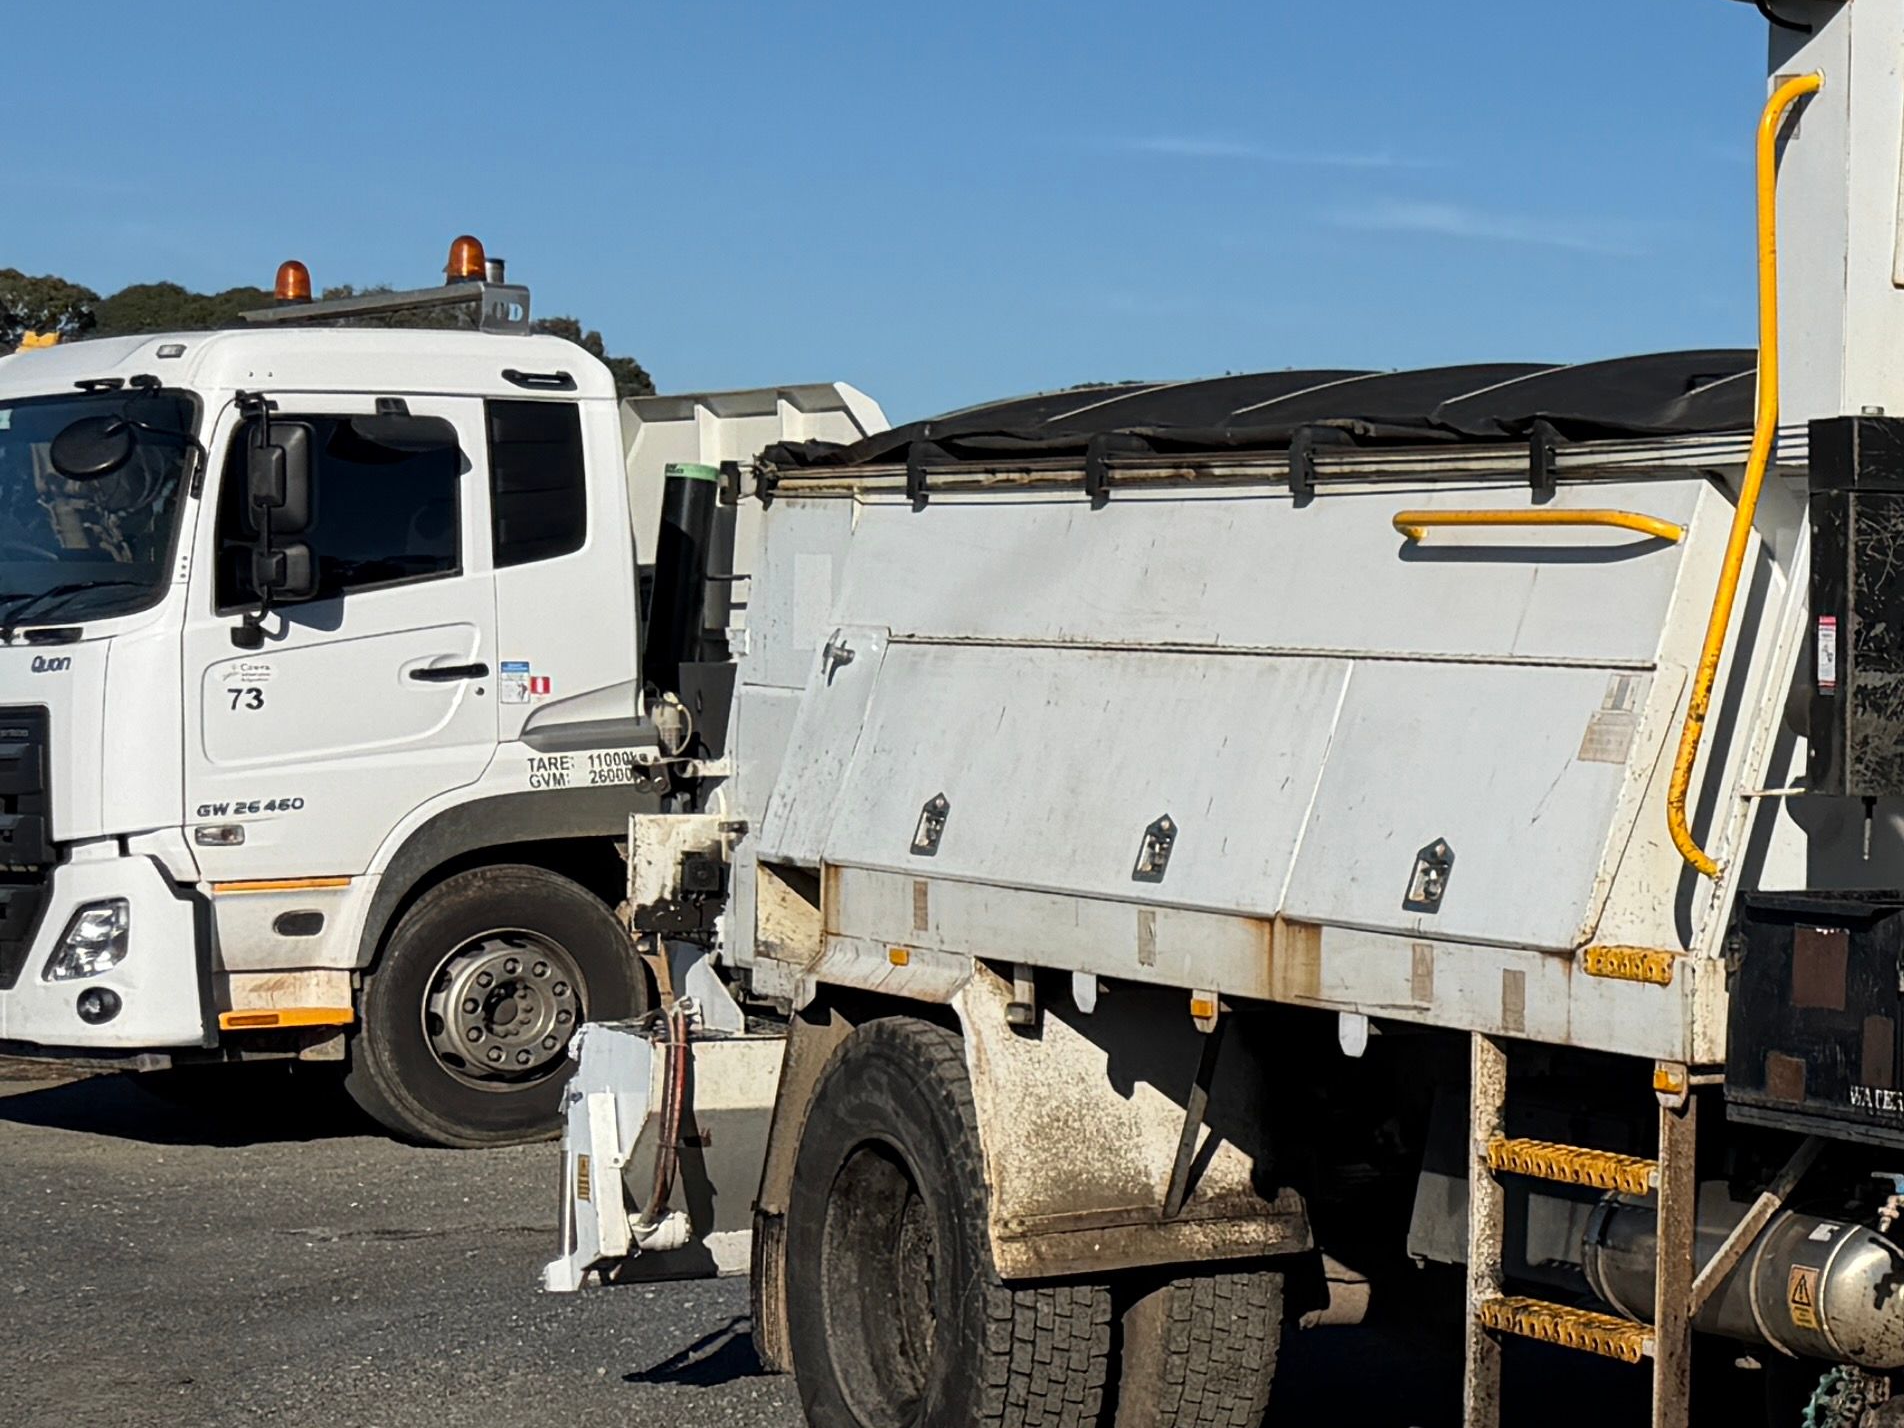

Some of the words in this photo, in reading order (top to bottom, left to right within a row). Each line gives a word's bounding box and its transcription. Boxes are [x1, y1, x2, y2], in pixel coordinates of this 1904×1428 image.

[31, 655, 72, 673] Quon
[227, 687, 265, 711] 73
[527, 755, 574, 773] TARE:
[529, 773, 570, 789] GVM:
[196, 803, 230, 818] GW
[233, 800, 261, 815] 26
[263, 797, 305, 813] 460
[1850, 1085, 1904, 1112] WATER
